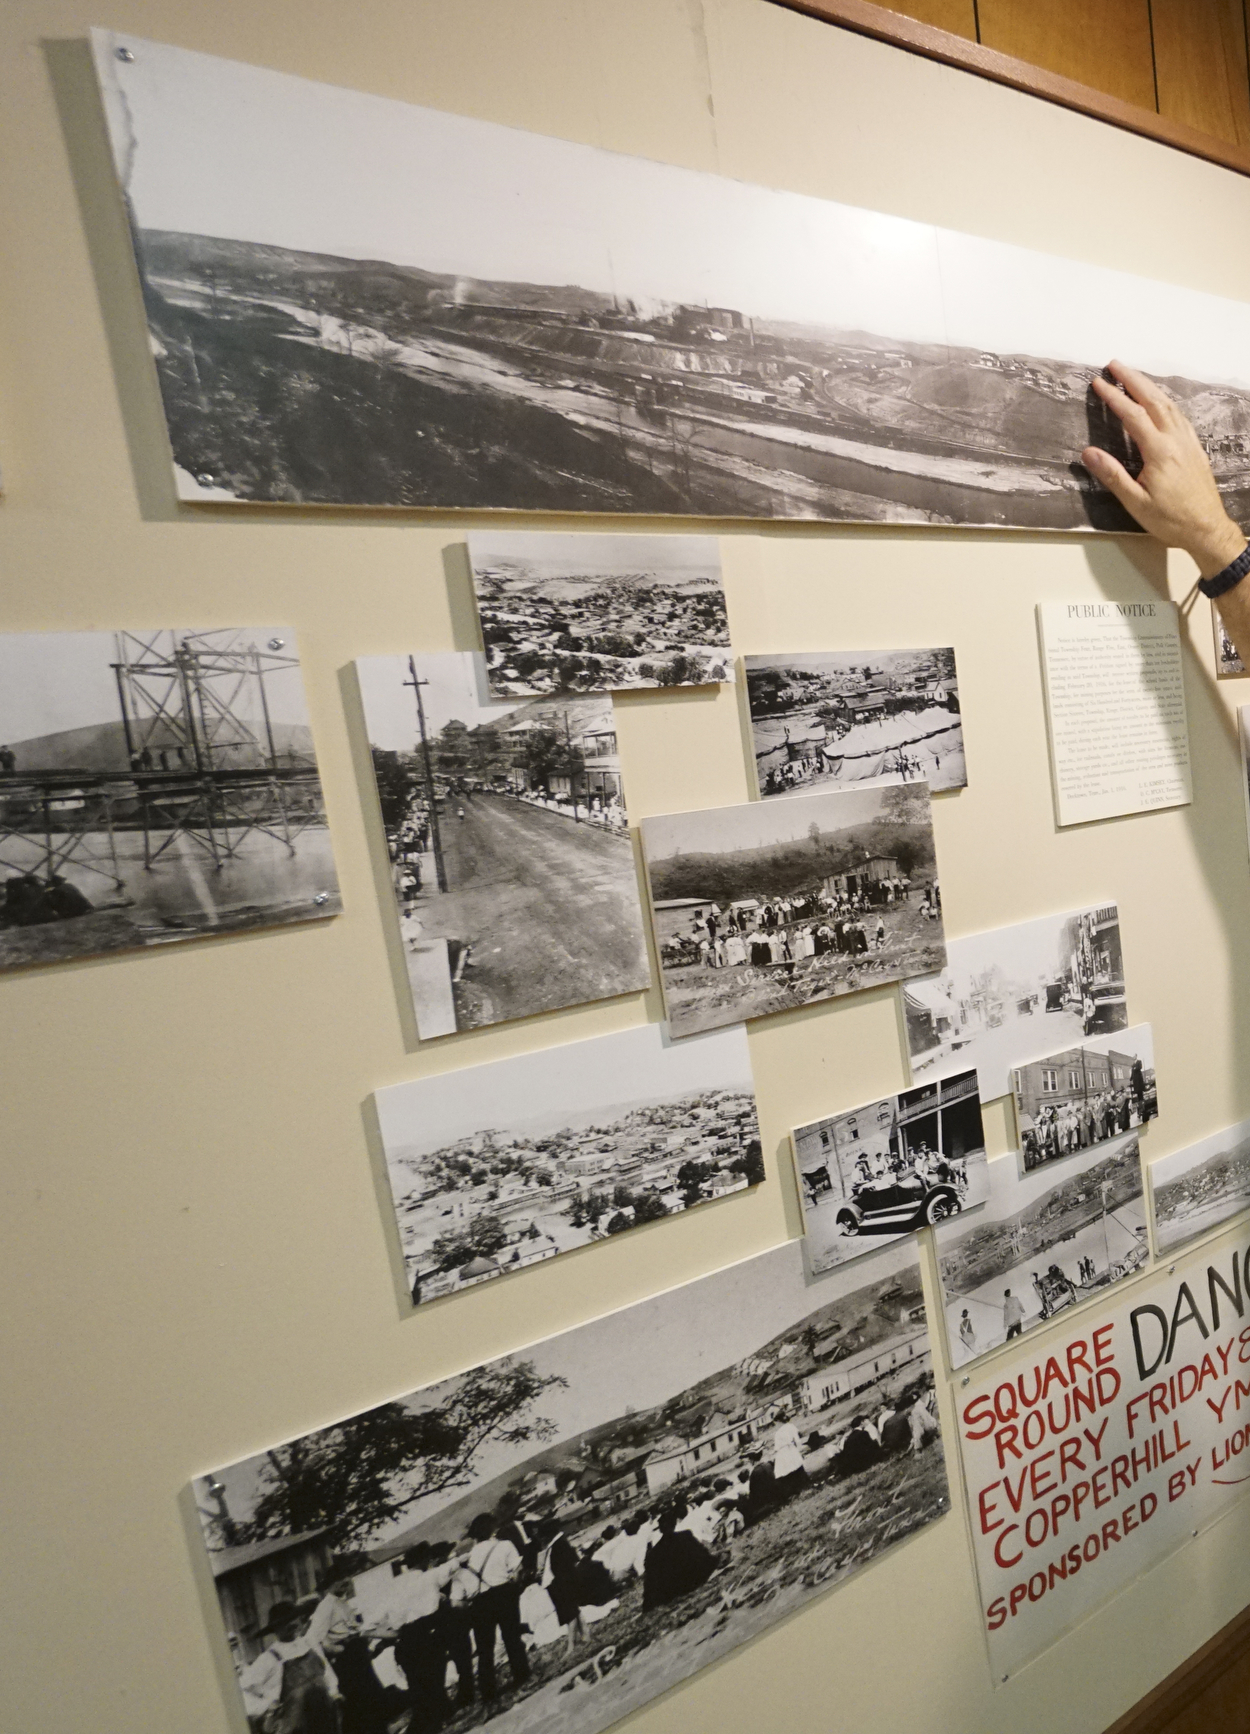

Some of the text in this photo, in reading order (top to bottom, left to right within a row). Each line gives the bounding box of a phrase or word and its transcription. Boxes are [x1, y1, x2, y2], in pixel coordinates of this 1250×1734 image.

[1067, 603, 1157, 618] PUBLIC NOTICE
[962, 1322, 1115, 1441] SQUARE
[979, 1416, 1109, 1535] EVERY
[1126, 1338, 1235, 1441] FRIDAY
[994, 1366, 1122, 1469] ROUND
[985, 1493, 1159, 1632] SPONSORED
[1168, 1457, 1203, 1506] BY
[993, 1419, 1191, 1570] COPPERHILL
